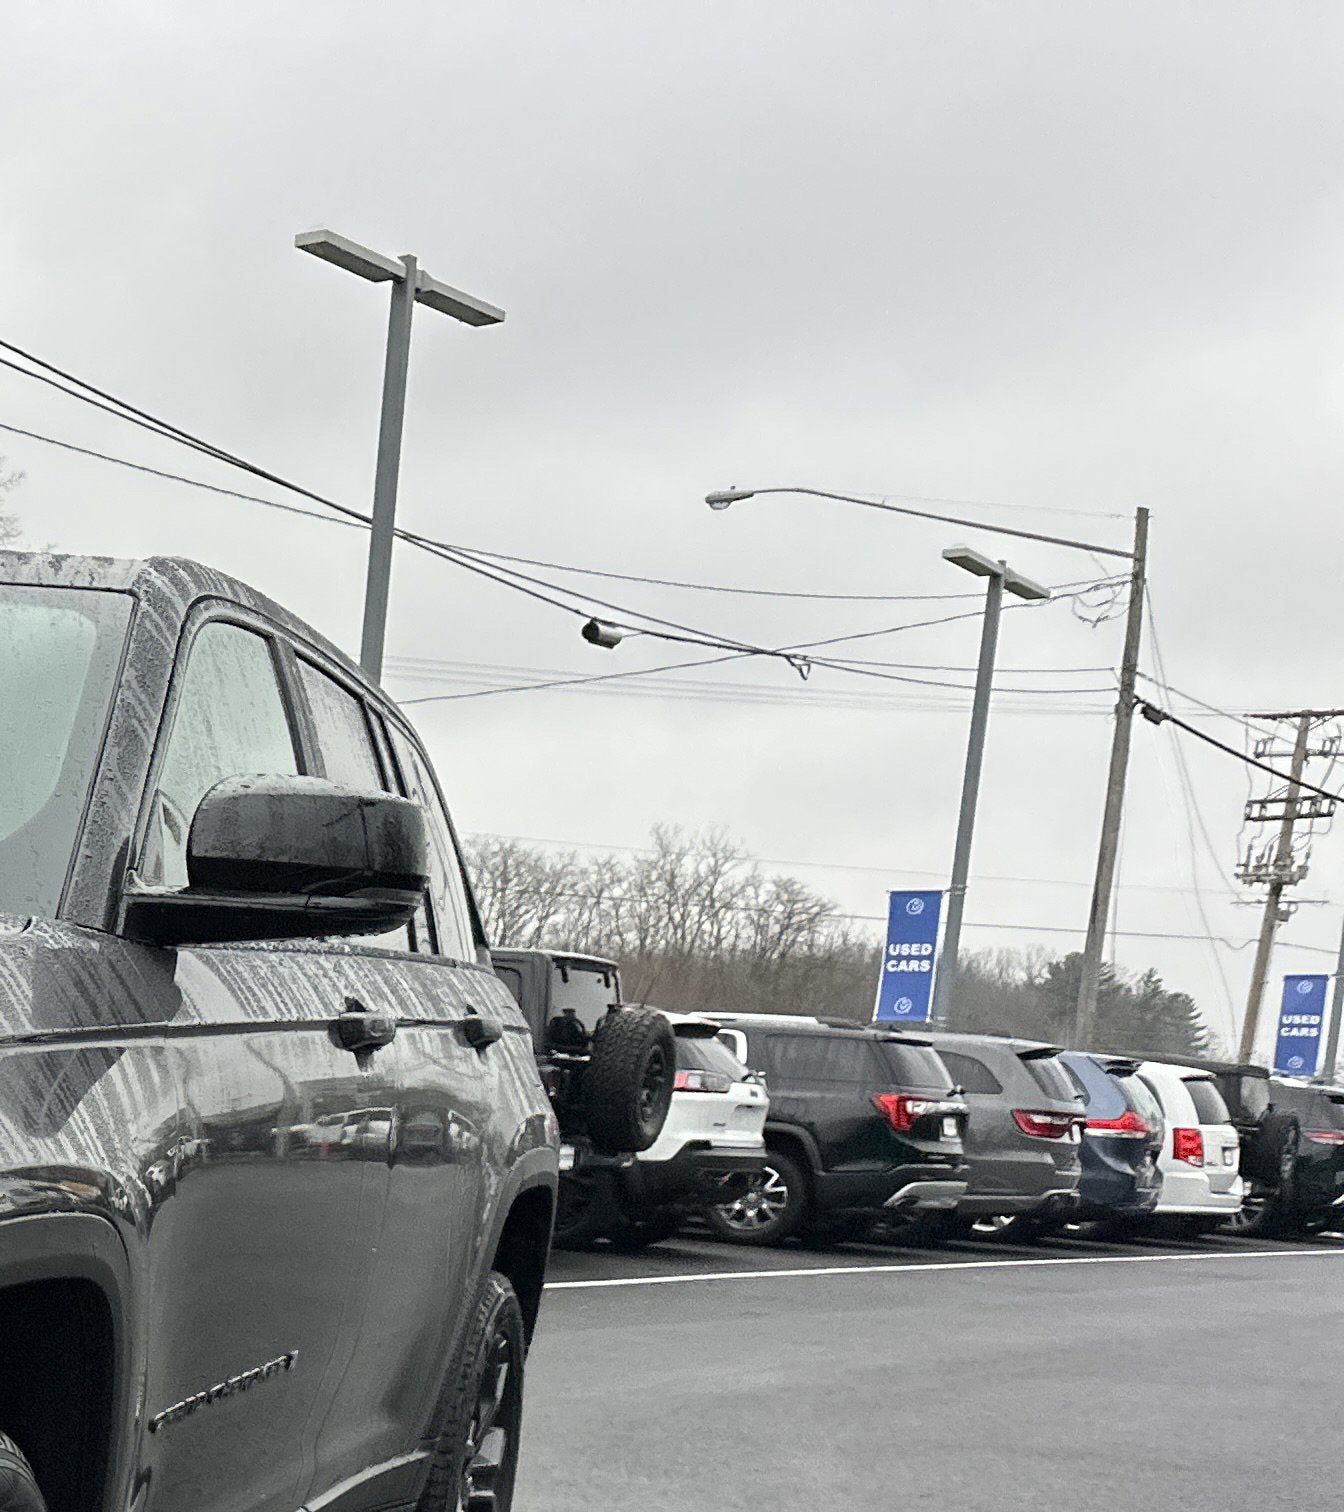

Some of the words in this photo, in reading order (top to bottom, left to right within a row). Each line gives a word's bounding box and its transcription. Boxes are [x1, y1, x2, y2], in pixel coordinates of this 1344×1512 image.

[888, 943, 933, 956] USED
[886, 959, 931, 973] CARS
[1282, 1014, 1321, 1025] USED
[1280, 1026, 1319, 1037] CARS
